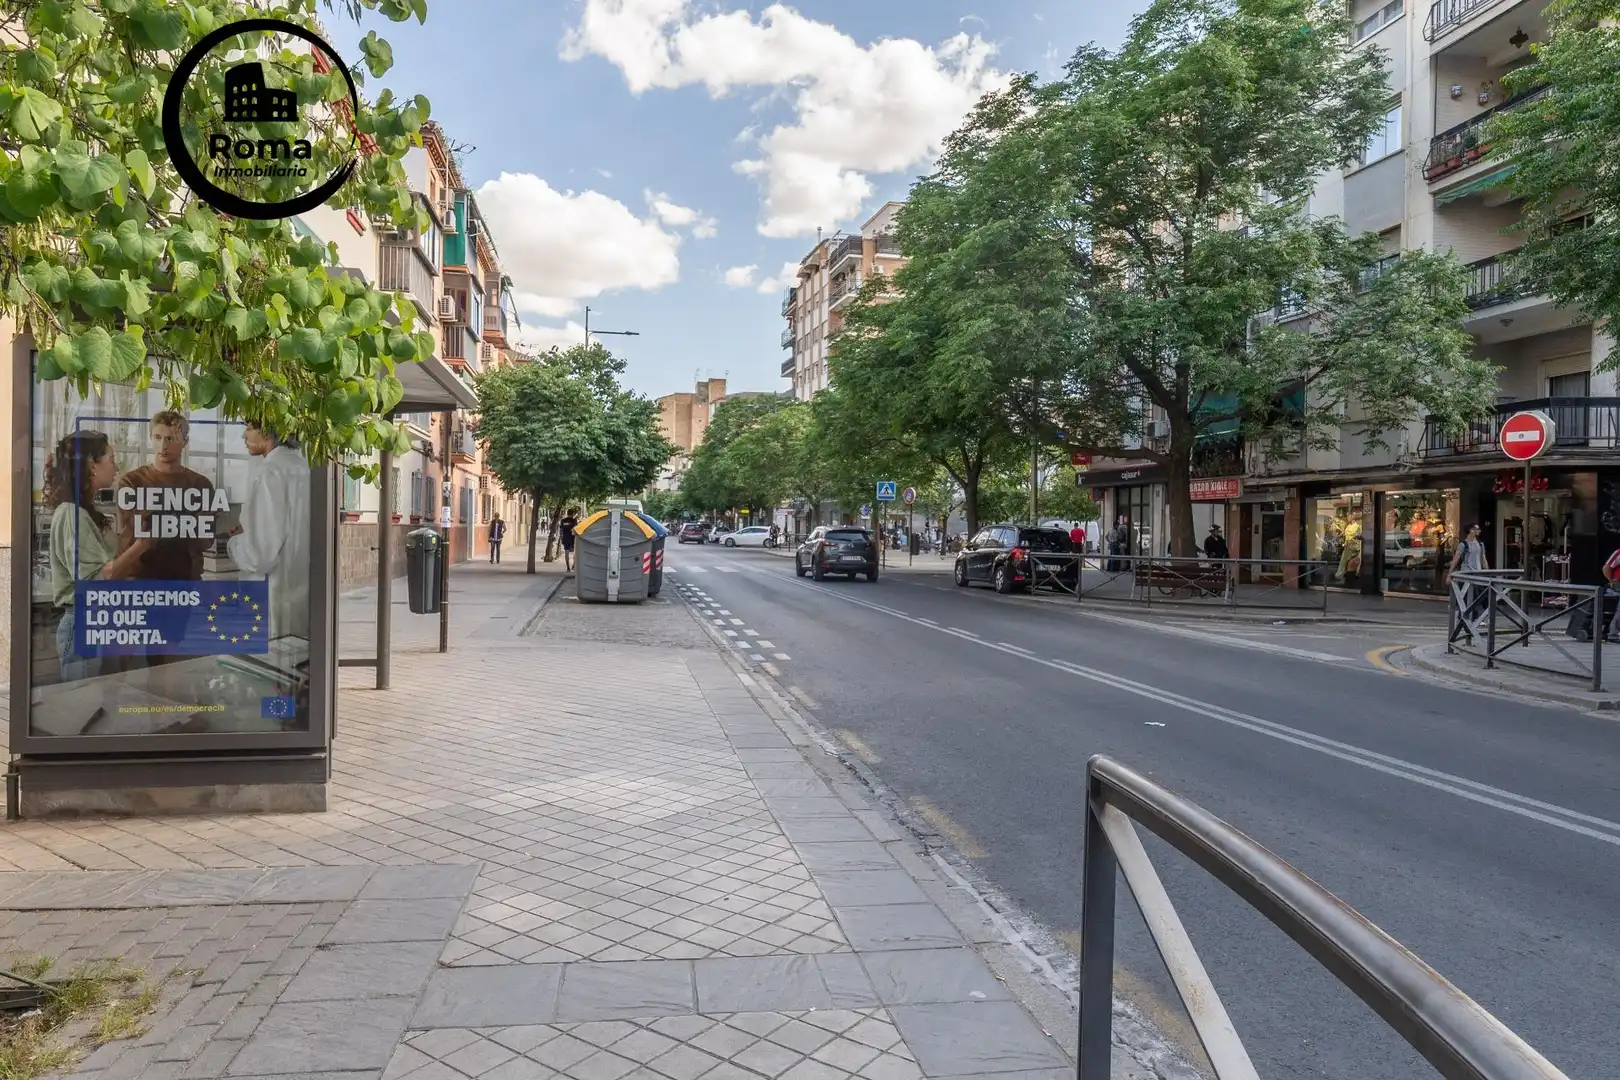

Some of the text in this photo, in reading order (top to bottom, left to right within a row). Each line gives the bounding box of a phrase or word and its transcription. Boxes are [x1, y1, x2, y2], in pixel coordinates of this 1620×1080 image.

[1189, 482, 1210, 492] BAZAR
[117, 487, 230, 512] CIENCIA
[134, 515, 215, 539] LIBRE
[86, 590, 200, 606] PROTEGEMOS
[86, 609, 147, 628] LO QUE
[86, 629, 167, 645] IMPORTA.
